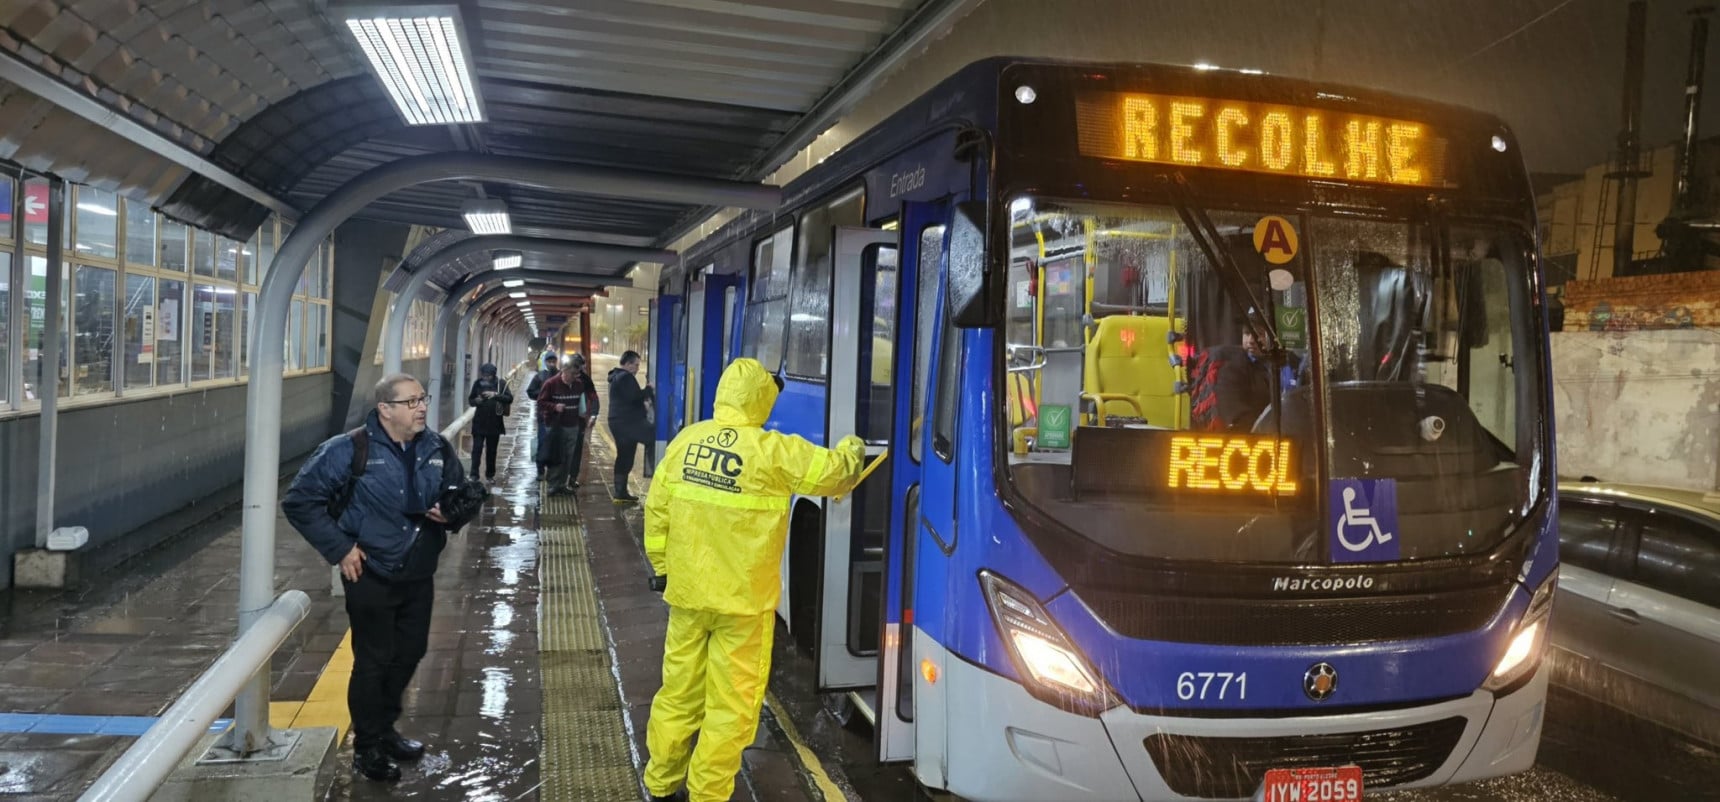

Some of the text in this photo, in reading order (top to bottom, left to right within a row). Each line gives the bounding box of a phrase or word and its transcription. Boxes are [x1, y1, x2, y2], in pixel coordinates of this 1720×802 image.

[1125, 97, 1421, 183] RECOLHE
[890, 163, 926, 198] Entrada
[1261, 219, 1293, 254] A
[684, 443, 743, 477] EPTC
[1168, 437, 1296, 491] RECOL
[1273, 575, 1374, 591] Marcopolo
[1177, 672, 1246, 700] 6771
[1270, 779, 1359, 802] IYW 2059
